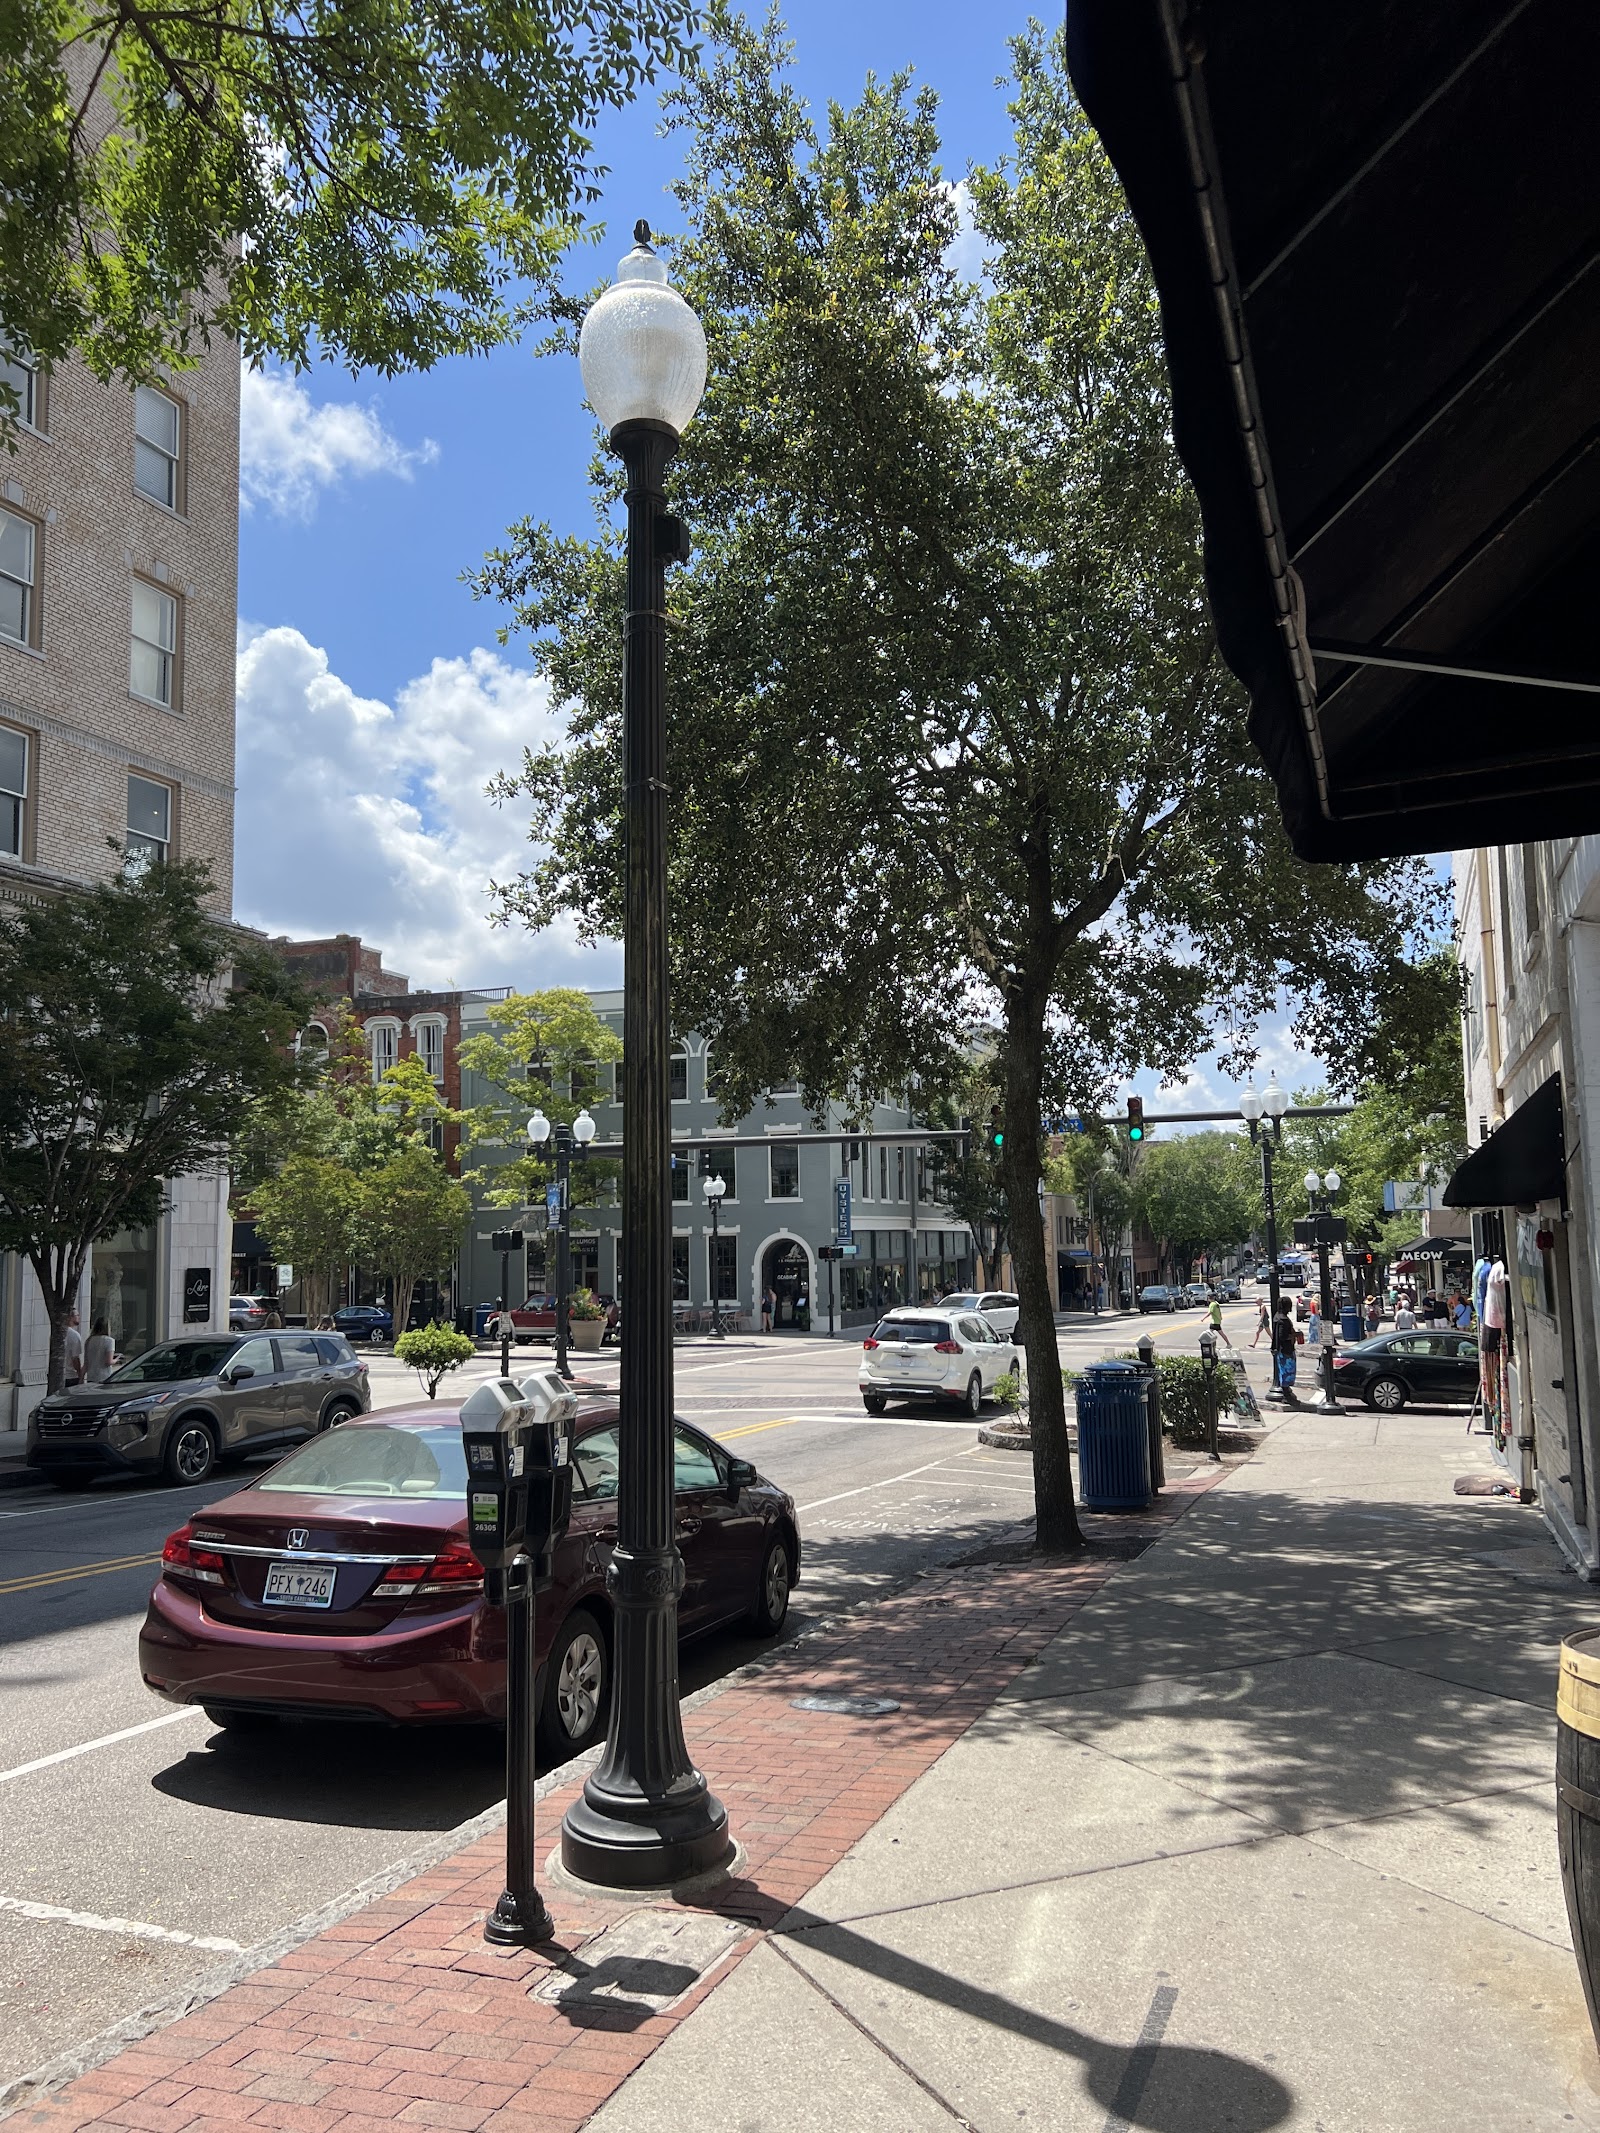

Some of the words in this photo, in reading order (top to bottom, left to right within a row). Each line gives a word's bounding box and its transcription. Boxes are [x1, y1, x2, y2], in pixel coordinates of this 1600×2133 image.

[839, 1184, 848, 1236] OYSTERS
[1365, 1253, 1373, 1264] 9
[1400, 1251, 1444, 1261] MEOW
[475, 1523, 497, 1532] 26305
[269, 1574, 294, 1594] PFX
[303, 1576, 328, 1596] 246
